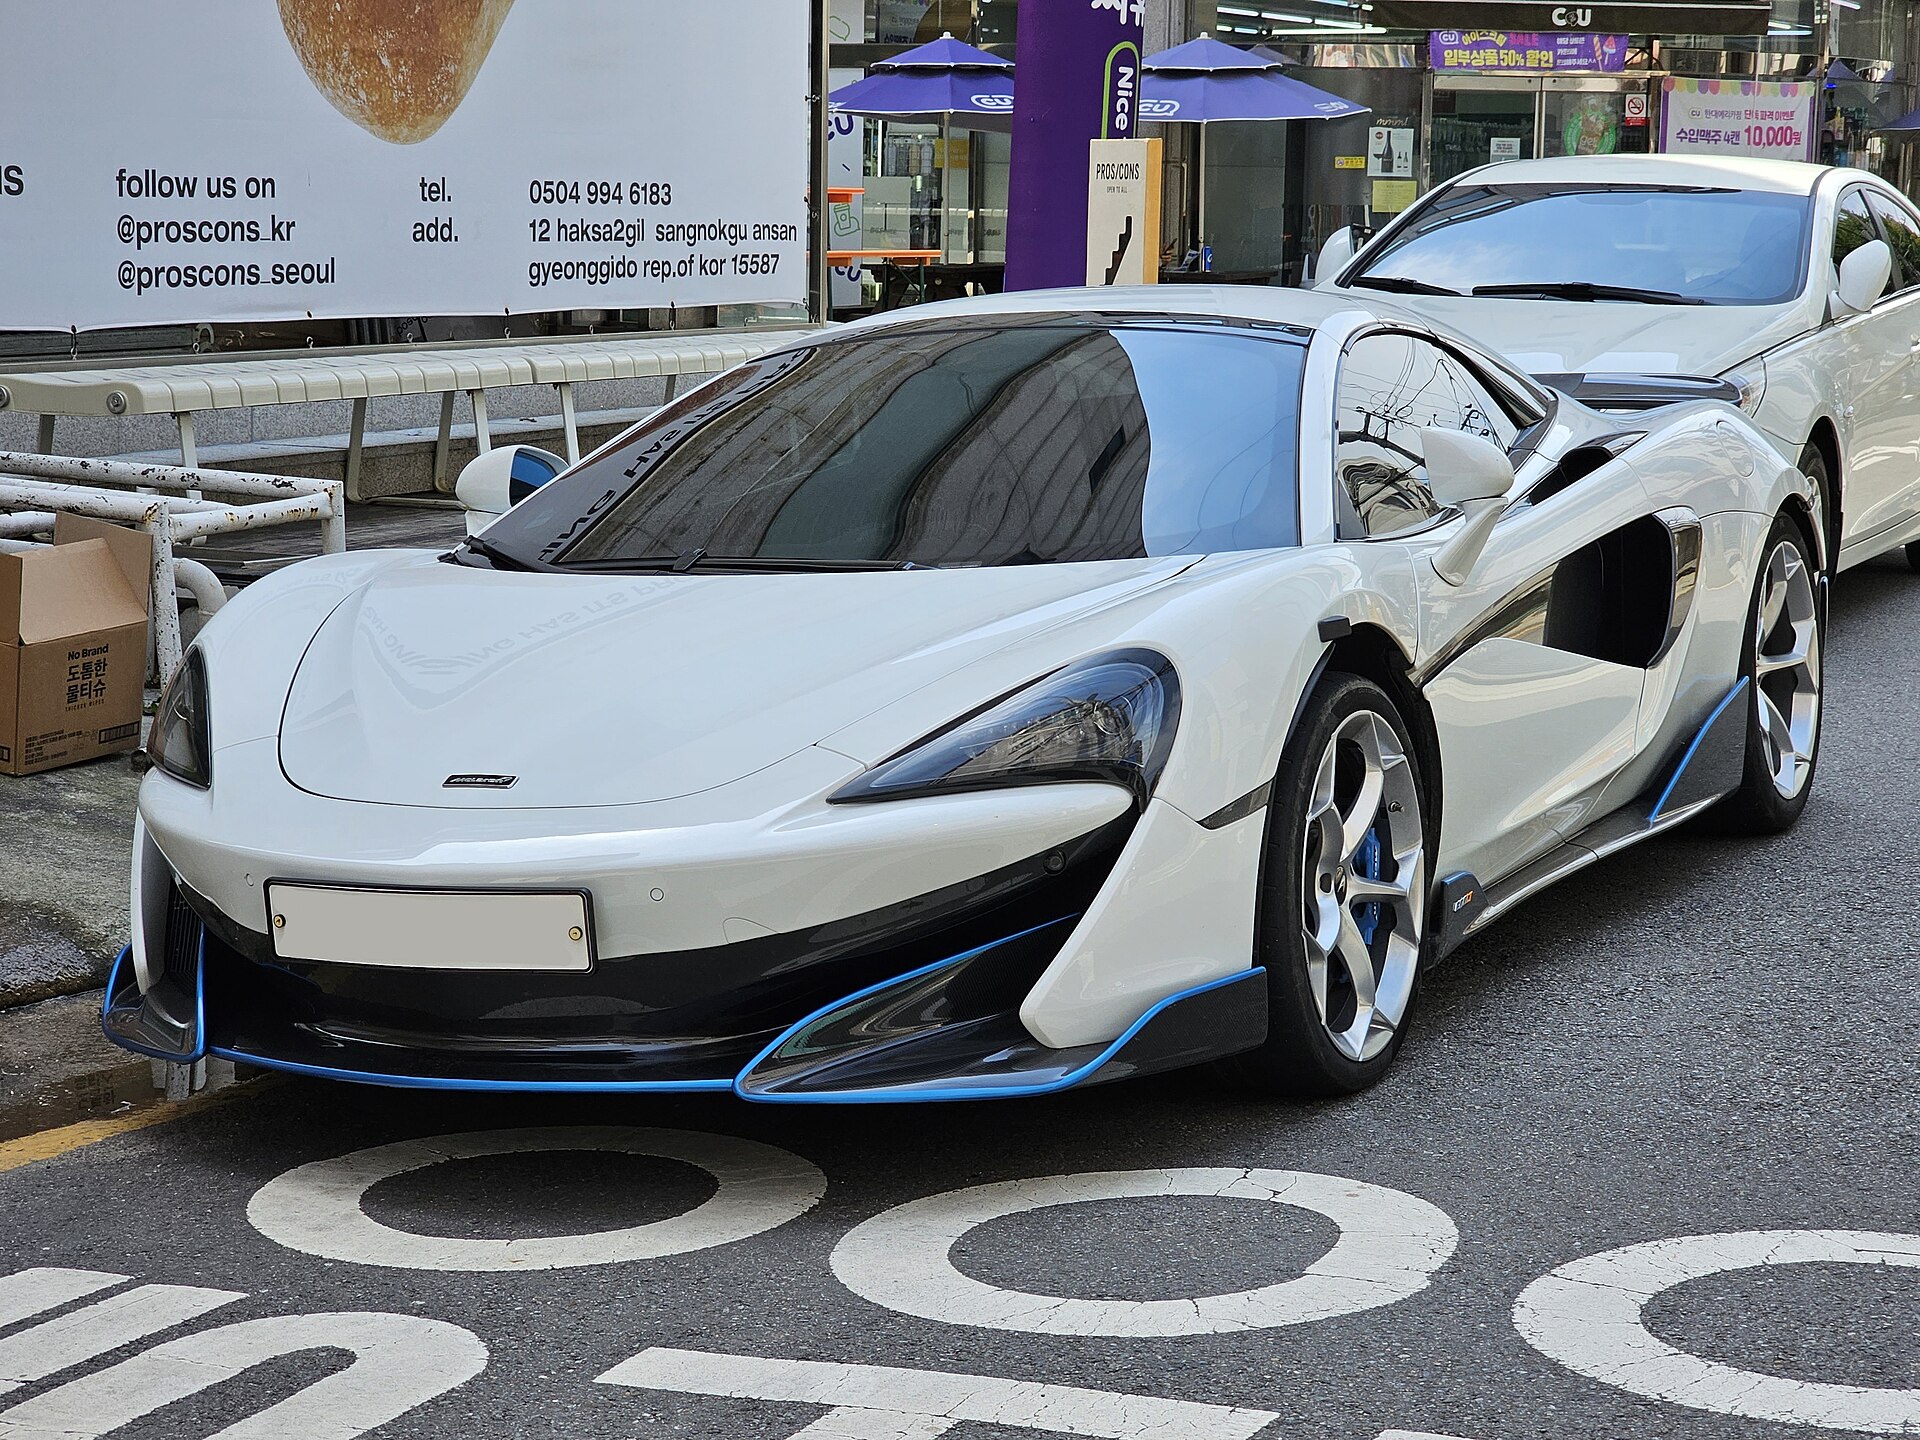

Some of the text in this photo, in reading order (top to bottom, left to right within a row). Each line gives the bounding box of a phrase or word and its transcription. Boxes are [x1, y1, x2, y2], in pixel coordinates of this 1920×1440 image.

[1552, 8, 1592, 27] CU
[1510, 33, 1540, 47] SALE
[1444, 49, 1554, 68] 일부상품 50% 할인
[981, 98, 1012, 106] CU
[1115, 66, 1135, 131] Nice
[1139, 103, 1171, 112] CU
[828, 114, 854, 136] U
[1691, 109, 1701, 117] CU
[1676, 125, 1803, 147] 수입맥주 4캔 10,000원
[116, 169, 276, 199] follow us on
[1096, 163, 1140, 180] PROS/CONS
[419, 176, 452, 203] tel.
[529, 180, 672, 206] 0504 994 6183
[117, 215, 296, 246] @proscons_kr
[412, 217, 459, 243] add.
[529, 218, 797, 248] 12 haksa2gil sangnokgu ansan
[117, 257, 335, 296] @proscons_seoul
[529, 254, 780, 288] gyeonggido rep.of kor 15587
[67, 643, 109, 661] No Brand
[66, 657, 108, 683] 도톰한
[66, 678, 107, 705] 물티슈
